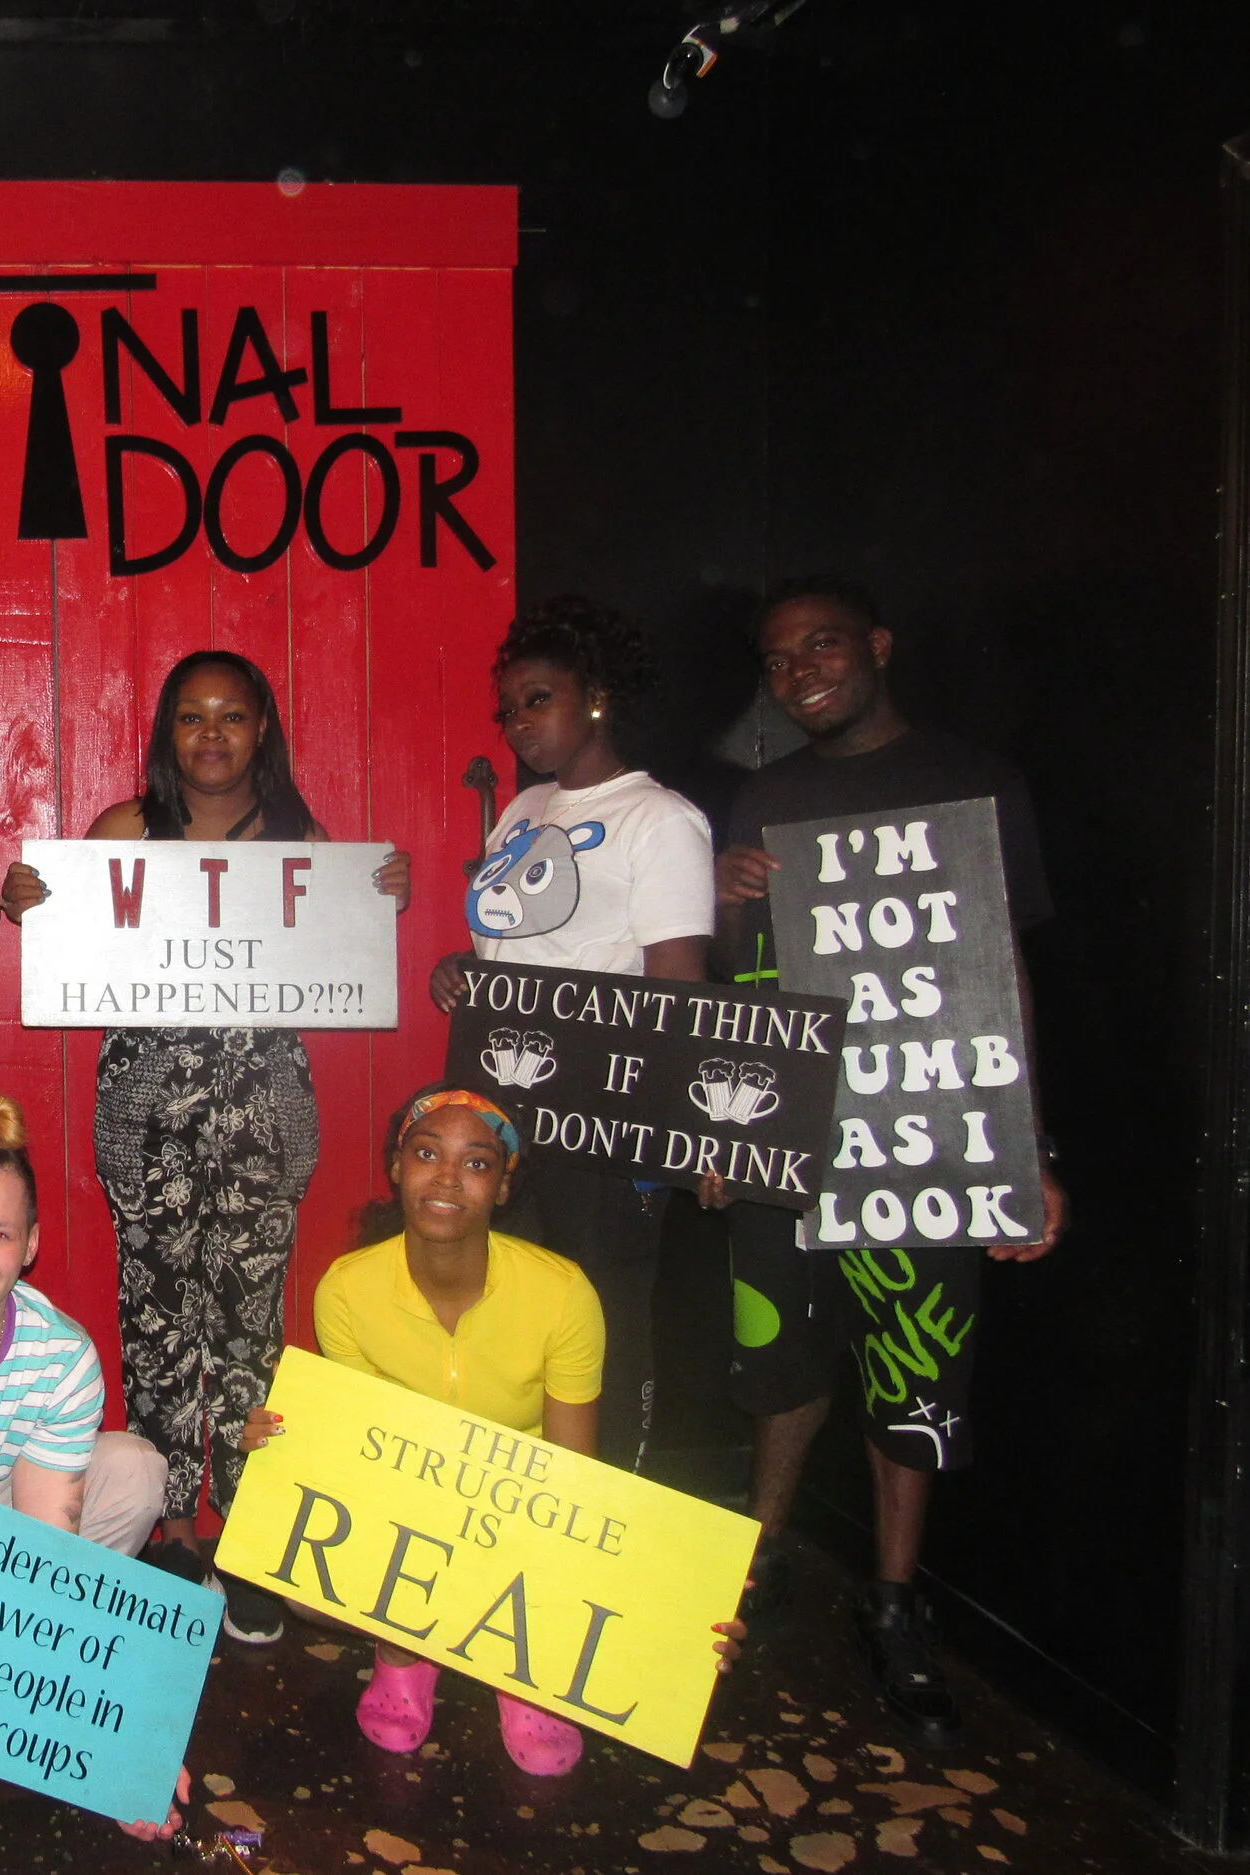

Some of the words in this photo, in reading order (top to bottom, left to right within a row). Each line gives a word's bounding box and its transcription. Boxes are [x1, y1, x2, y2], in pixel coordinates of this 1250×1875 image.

[105, 431, 497, 577] DOOR
[816, 821, 939, 883] I'M
[811, 891, 957, 955] NOT
[159, 938, 263, 970] JUST
[60, 982, 364, 1014] HAPPENED?!?!
[463, 970, 543, 1015] YOU
[551, 981, 676, 1034] CAN'T
[687, 998, 833, 1054] THINK
[846, 966, 942, 1024] AS
[603, 1053, 644, 1094] IF
[842, 1035, 1020, 1095] UMB
[532, 1106, 654, 1164] DON'T
[661, 1130, 812, 1196] DRINK
[833, 1114, 933, 1170] AS
[962, 1111, 995, 1163] I
[817, 1185, 1029, 1243] LOOK
[459, 1419, 554, 1484] THE
[359, 1426, 628, 1556] STRUGGLE
[456, 1505, 502, 1549] IS
[265, 1482, 640, 1727] REAL
[79, 1633, 126, 1671] of
[92, 1689, 125, 1733] in
